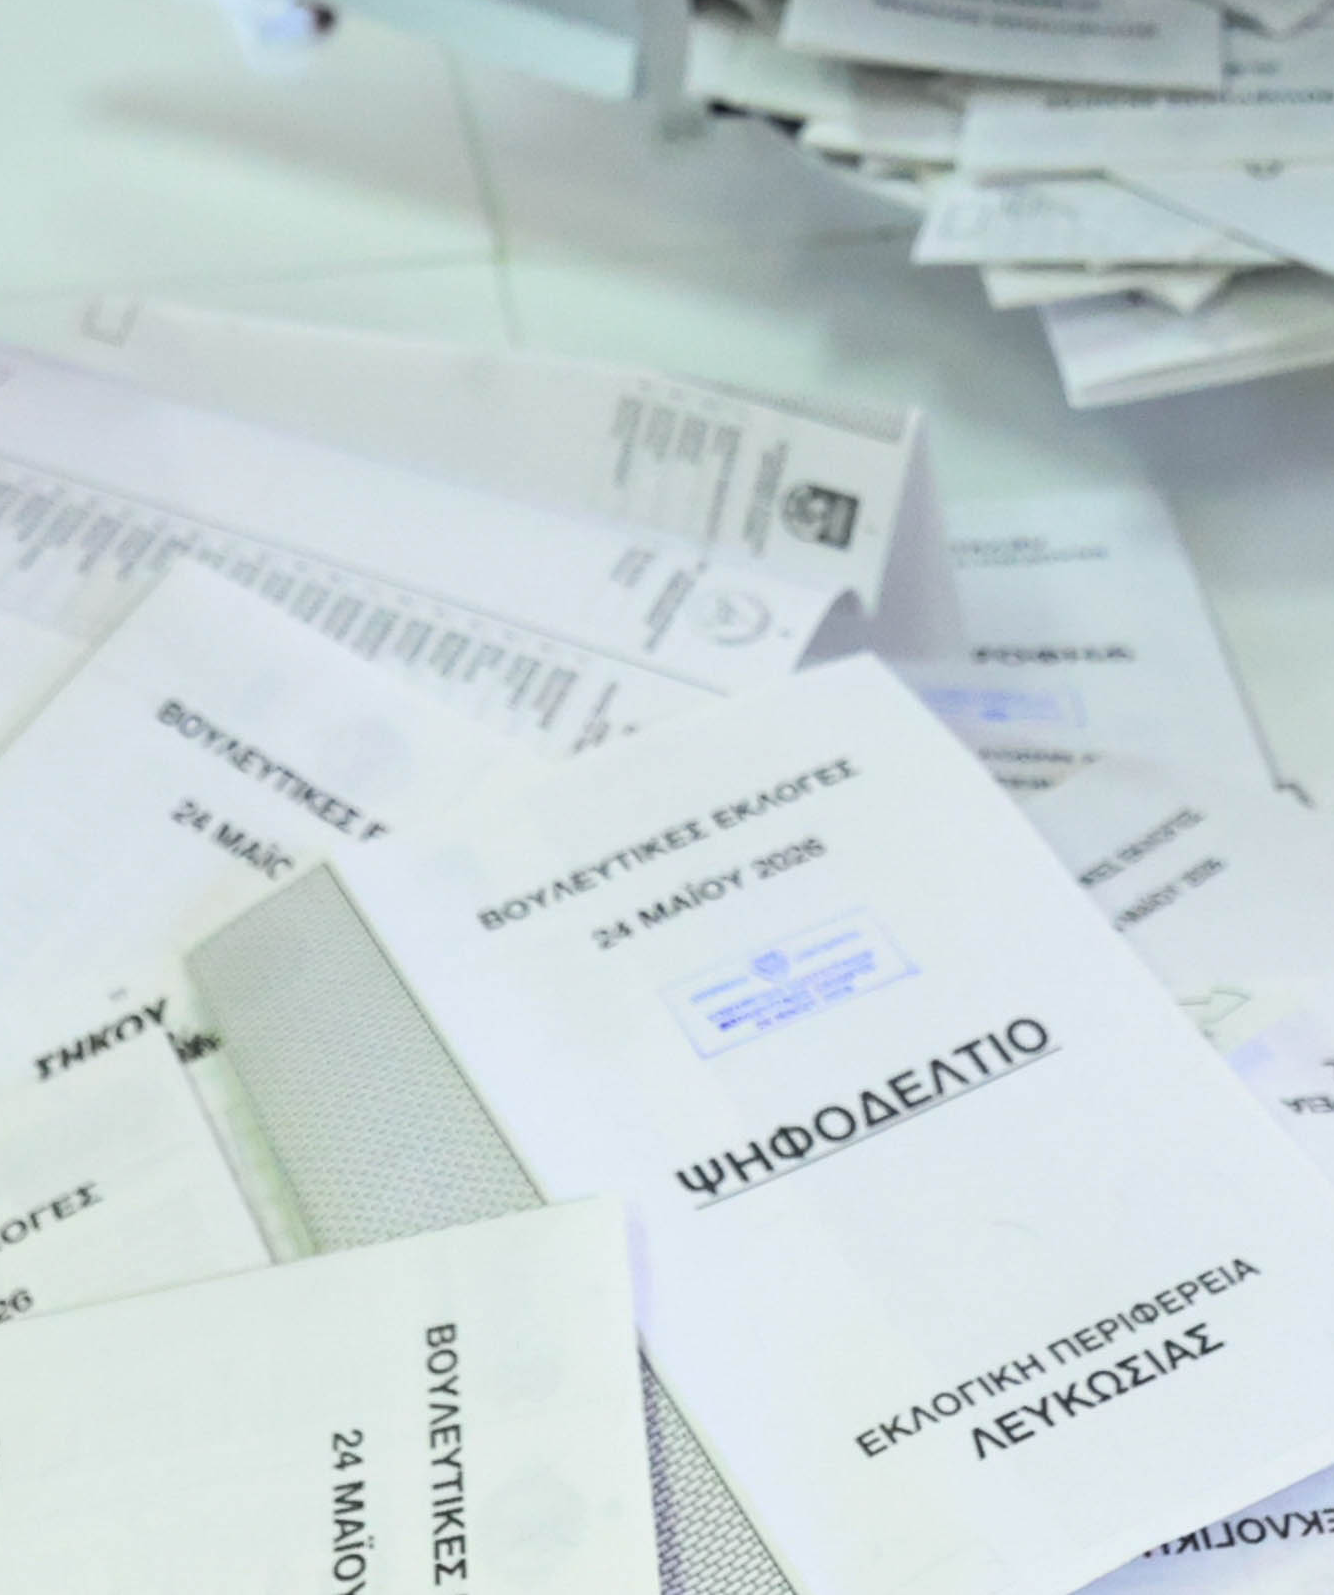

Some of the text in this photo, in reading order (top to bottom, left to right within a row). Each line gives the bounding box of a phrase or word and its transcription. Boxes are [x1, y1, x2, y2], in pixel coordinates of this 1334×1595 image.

[157, 699, 360, 834] ΒΟΥΛΕΥΤΙΚΕΣ
[477, 757, 859, 930] ΒΟΥΛΕΥΤΙΚΕΣ ΕΚΛΟΓΕΣ
[592, 836, 827, 950] 24 ΜΑΪΟΥ 2026
[676, 1017, 1050, 1195] ΨΗΦΟΔΕΛΤΙΟ
[854, 1256, 1262, 1458] ΕΚΛΟΓΙΚΗ ΠΕΡΙΦΕΡΕΙΑ
[970, 1321, 1225, 1461] ΛΕΥΚΩΣΙΑΣ
[332, 1428, 364, 1471] 24
[425, 1323, 468, 1586] ΒΟΥΛΕΥΤΙΚΕΣ
